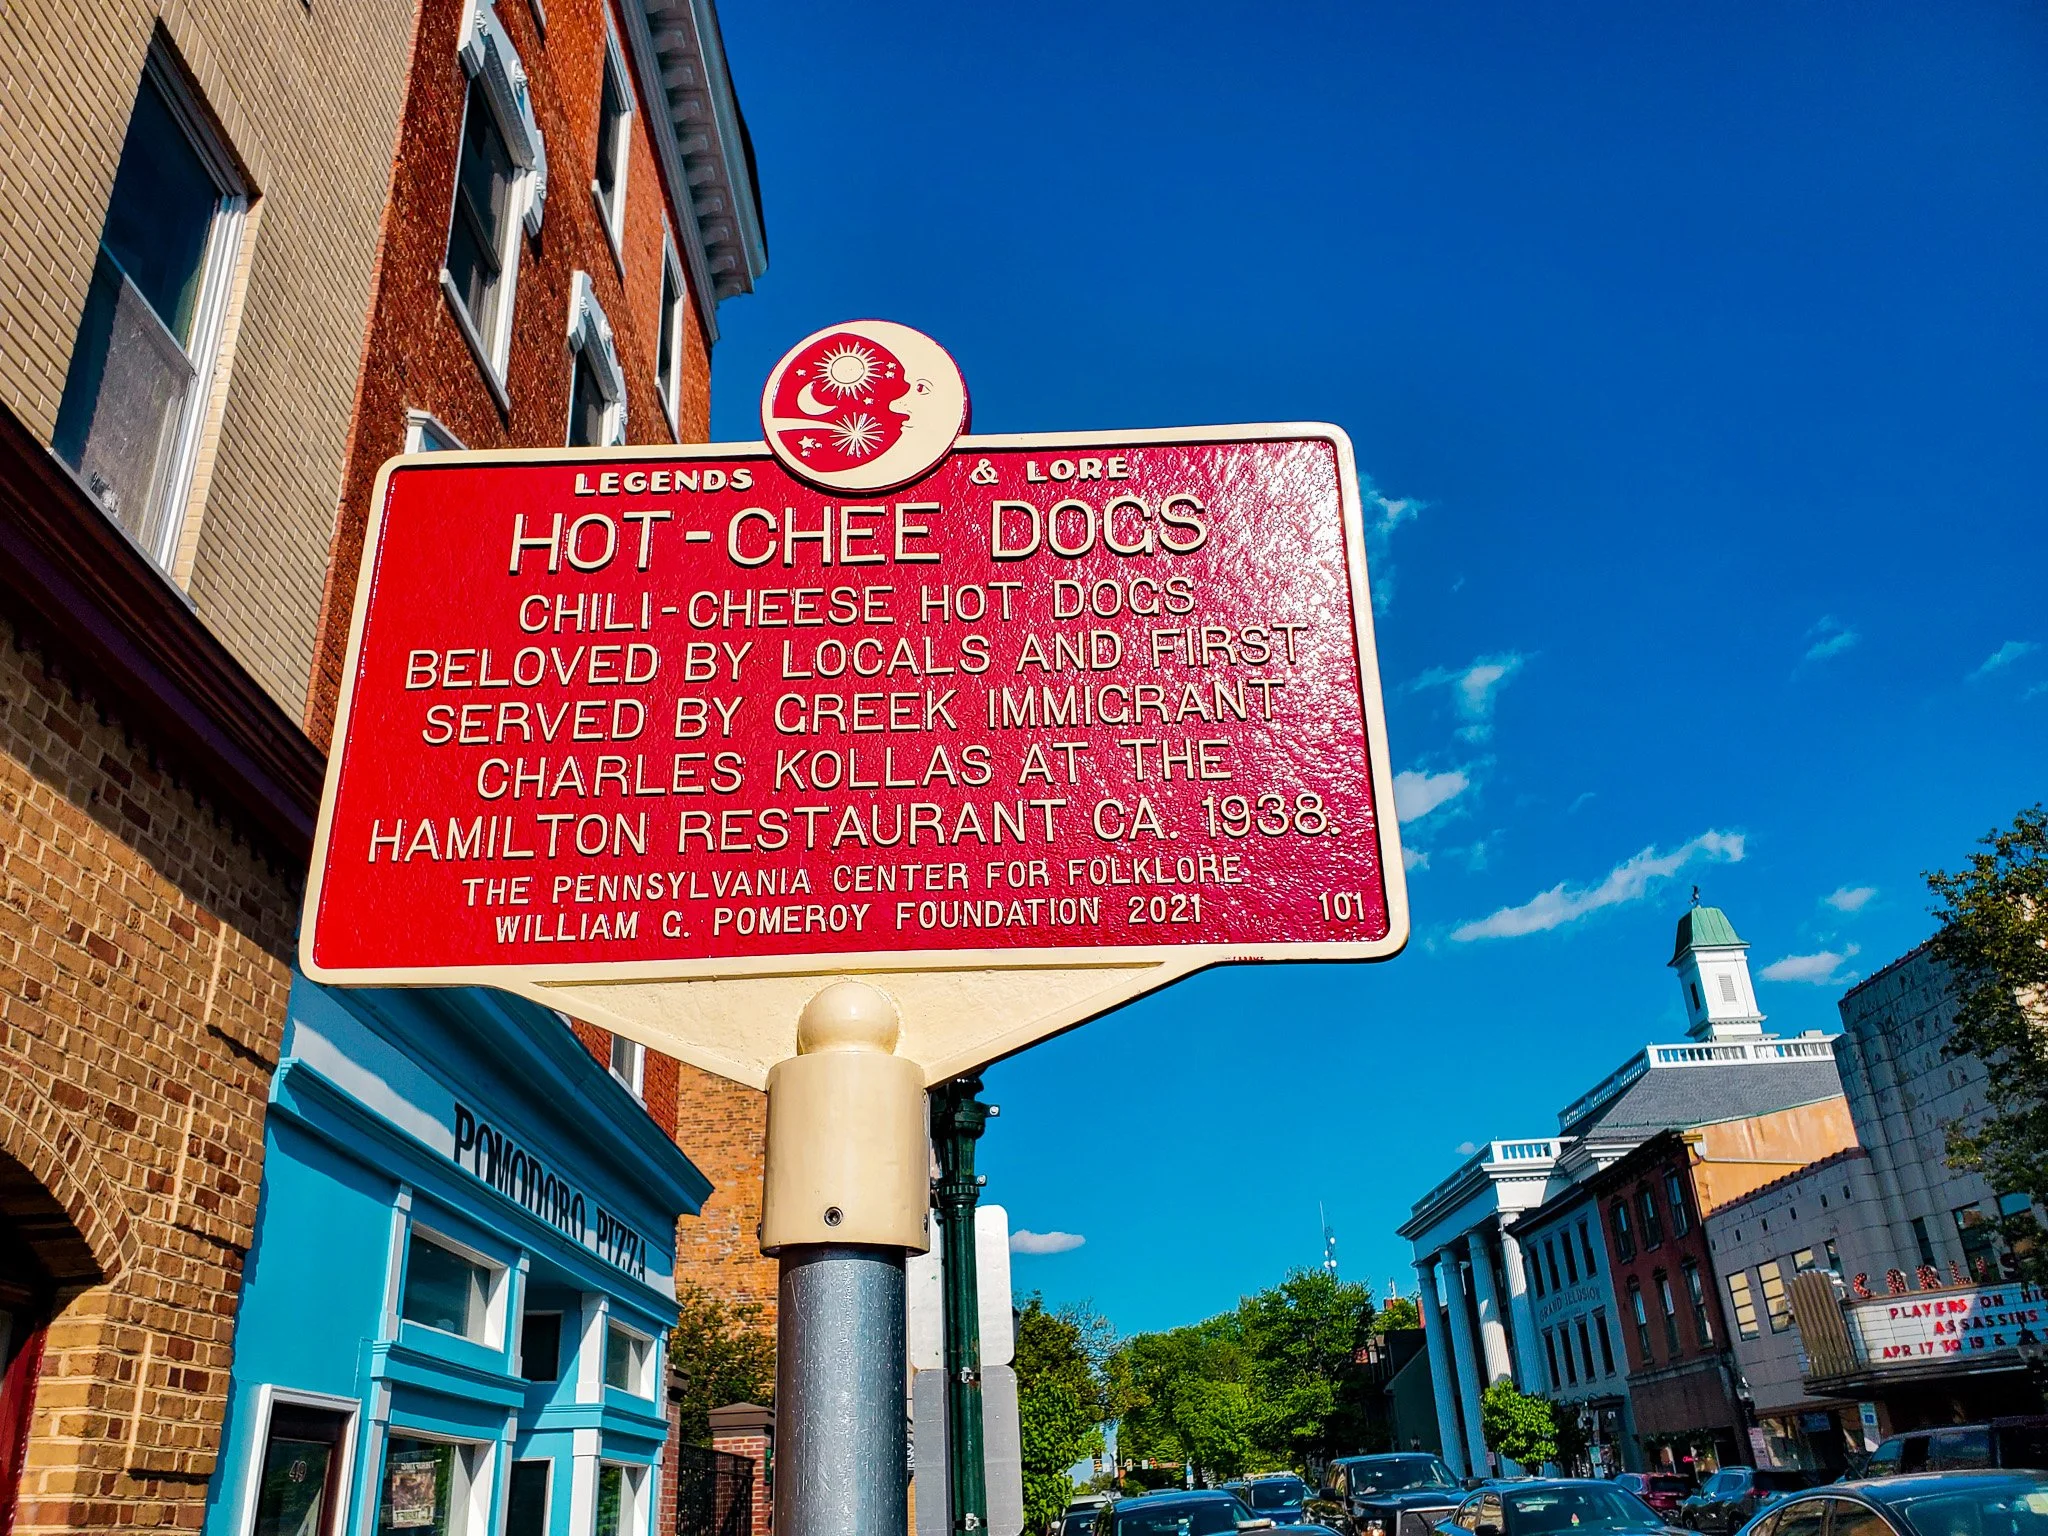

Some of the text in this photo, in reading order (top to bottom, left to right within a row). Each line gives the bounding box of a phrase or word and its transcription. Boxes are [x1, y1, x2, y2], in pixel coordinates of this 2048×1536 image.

[575, 456, 1129, 495] LEGENDS & LORE
[990, 493, 1208, 560] DOGS
[519, 576, 1195, 634] CHILI-CHEESE HOT DOGS
[405, 623, 1308, 690] BELOVED BY LOCALS AND FIRST
[422, 678, 1285, 745] SERVED BY GREEK IMMIGRANT
[477, 739, 1231, 800] CHARLES KOLLAS AT THE
[367, 795, 1341, 863] HAMILTON RESTAURANT CA. 1938.
[462, 855, 1242, 907] THE PENNSYLVANIA CENTER FOR FOLKLORE
[495, 894, 1202, 944] WILLIAM G. POMEROY FOUNDATION 2021
[1319, 892, 1366, 922] 101
[454, 1102, 647, 1284] POMODORO PIZZA
[1540, 1296, 1562, 1322] GRAND
[1889, 1298, 1968, 1320] PLAYERS
[1980, 1294, 2004, 1309] ON
[1933, 1309, 2038, 1336] ASSASSINS
[1882, 1344, 1912, 1360] APR
[1919, 1341, 1934, 1356] 17
[1941, 1338, 1962, 1352] TO
[289, 1460, 307, 1482] 49
